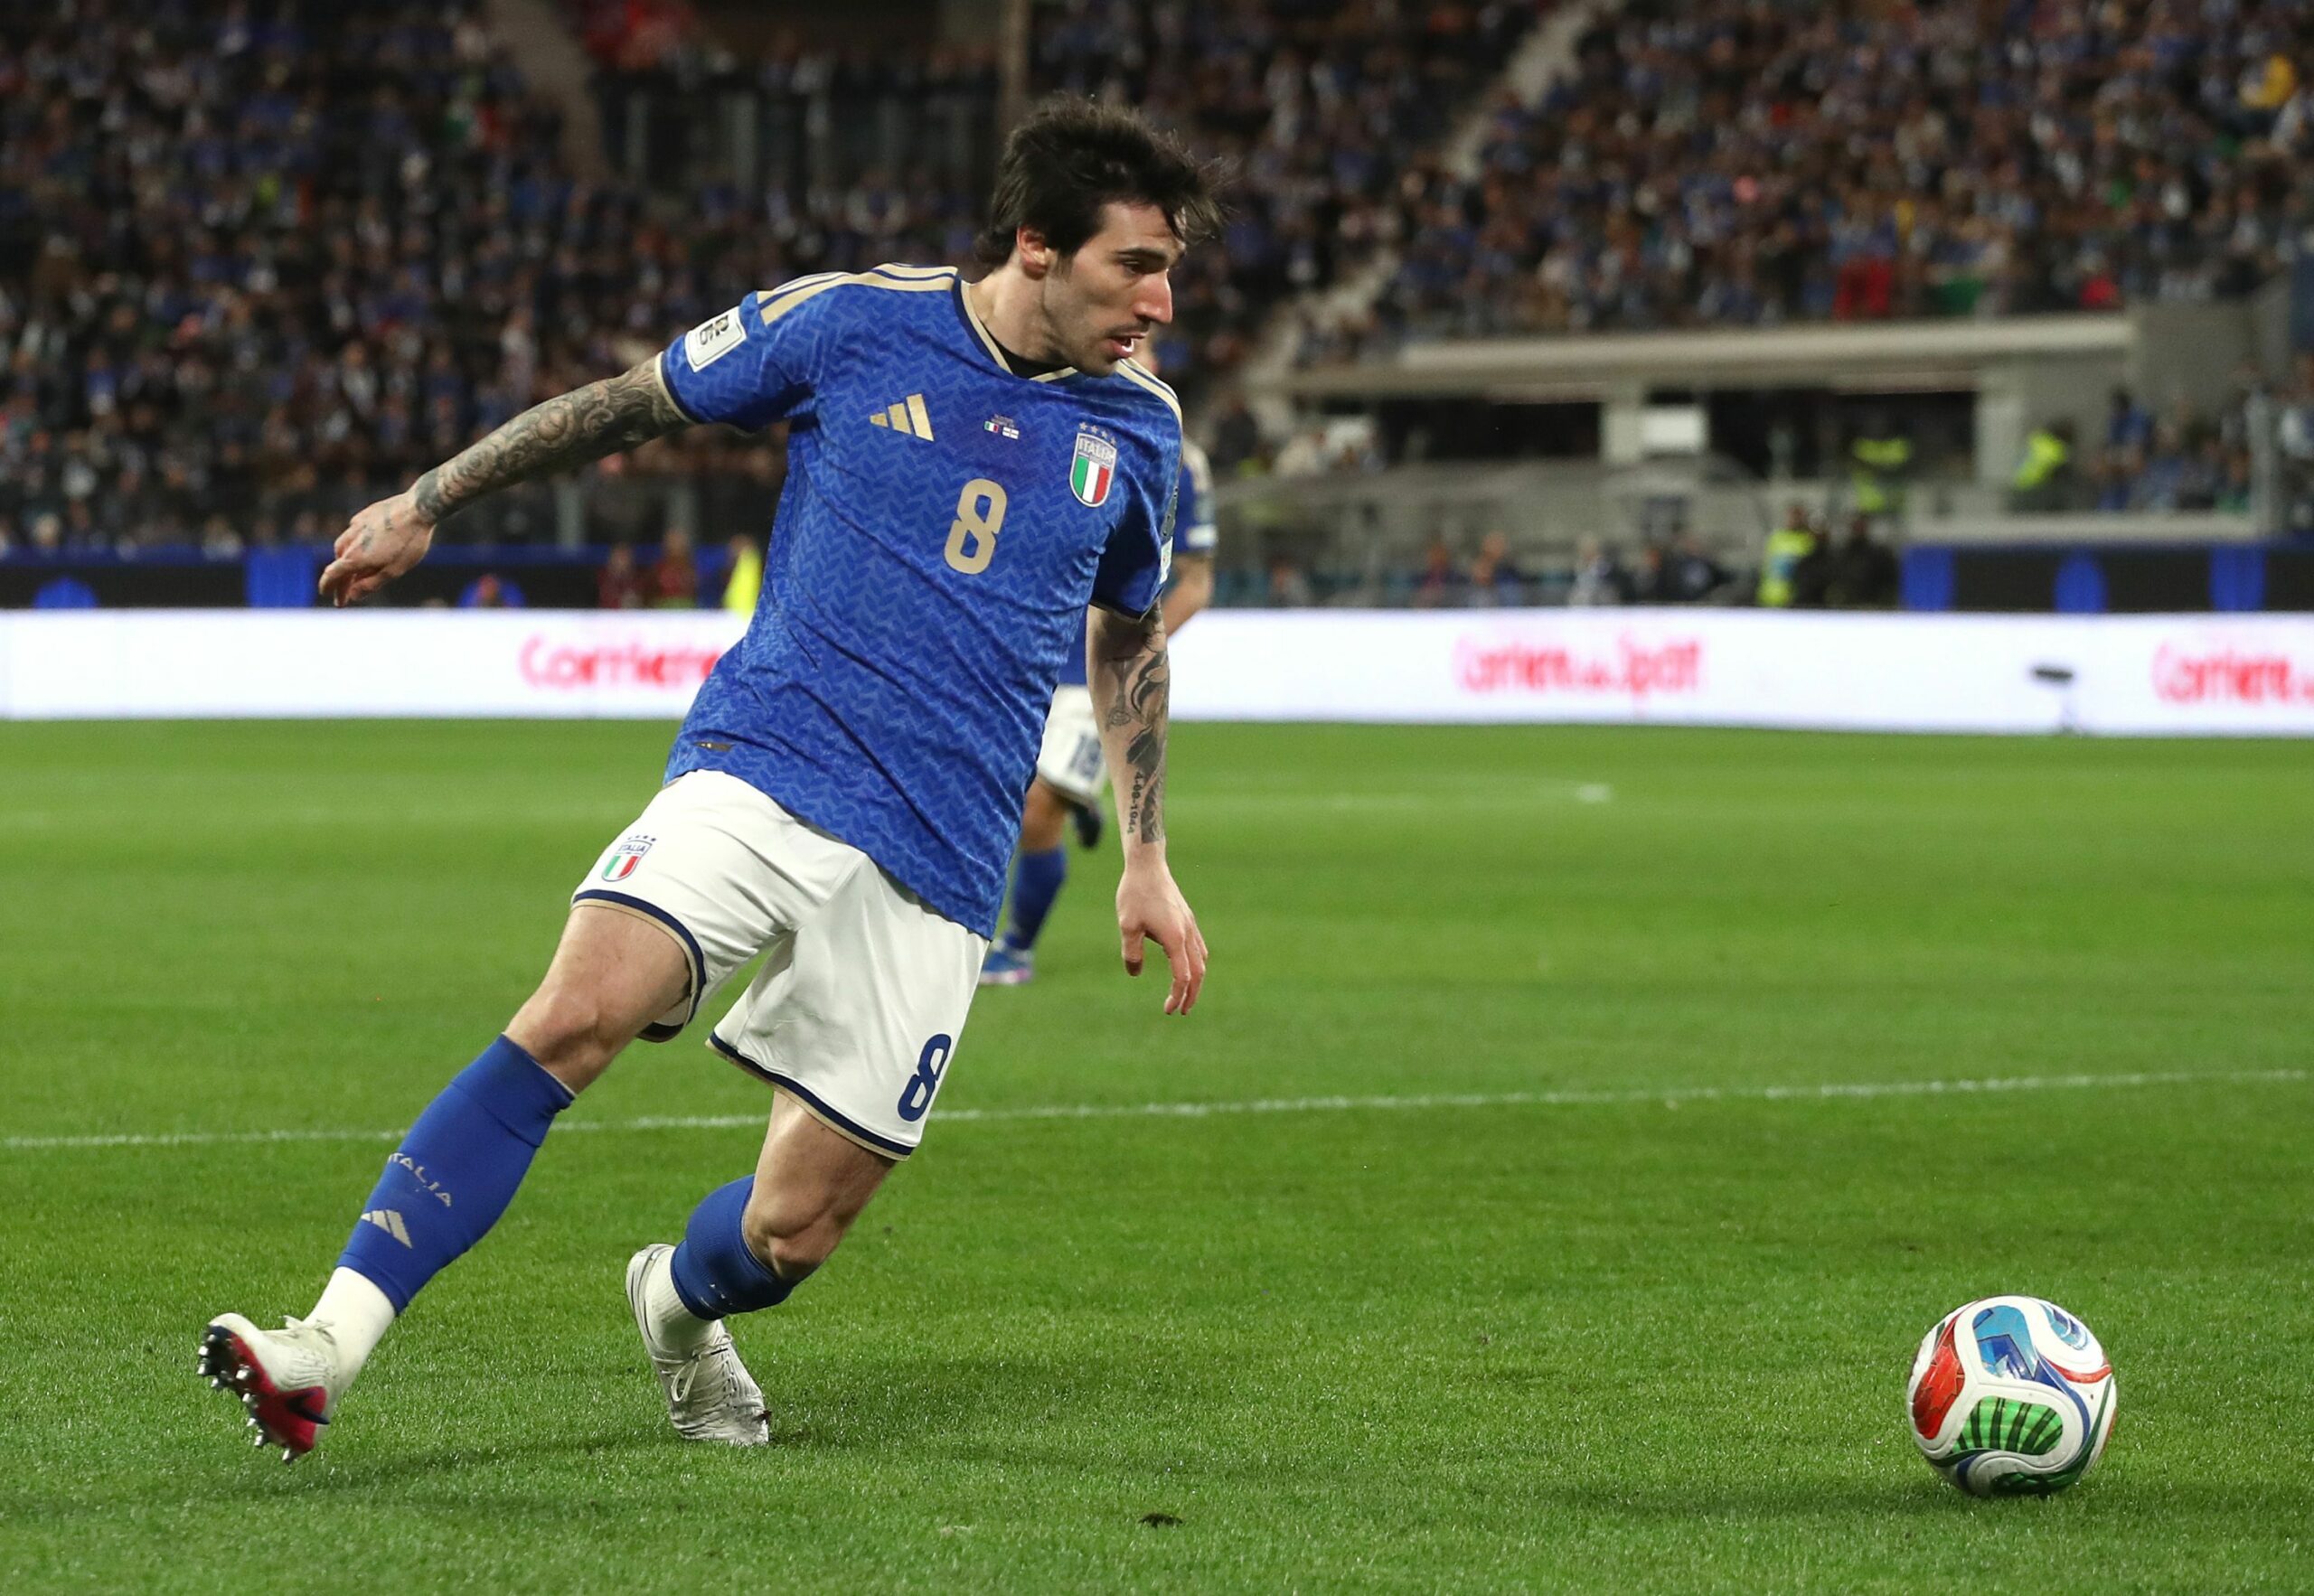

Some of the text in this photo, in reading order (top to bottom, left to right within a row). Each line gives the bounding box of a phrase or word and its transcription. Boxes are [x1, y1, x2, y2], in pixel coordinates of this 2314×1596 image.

[1077, 437, 1115, 464] ITALIA
[944, 478, 1008, 575] 8
[897, 1033, 952, 1122] 8
